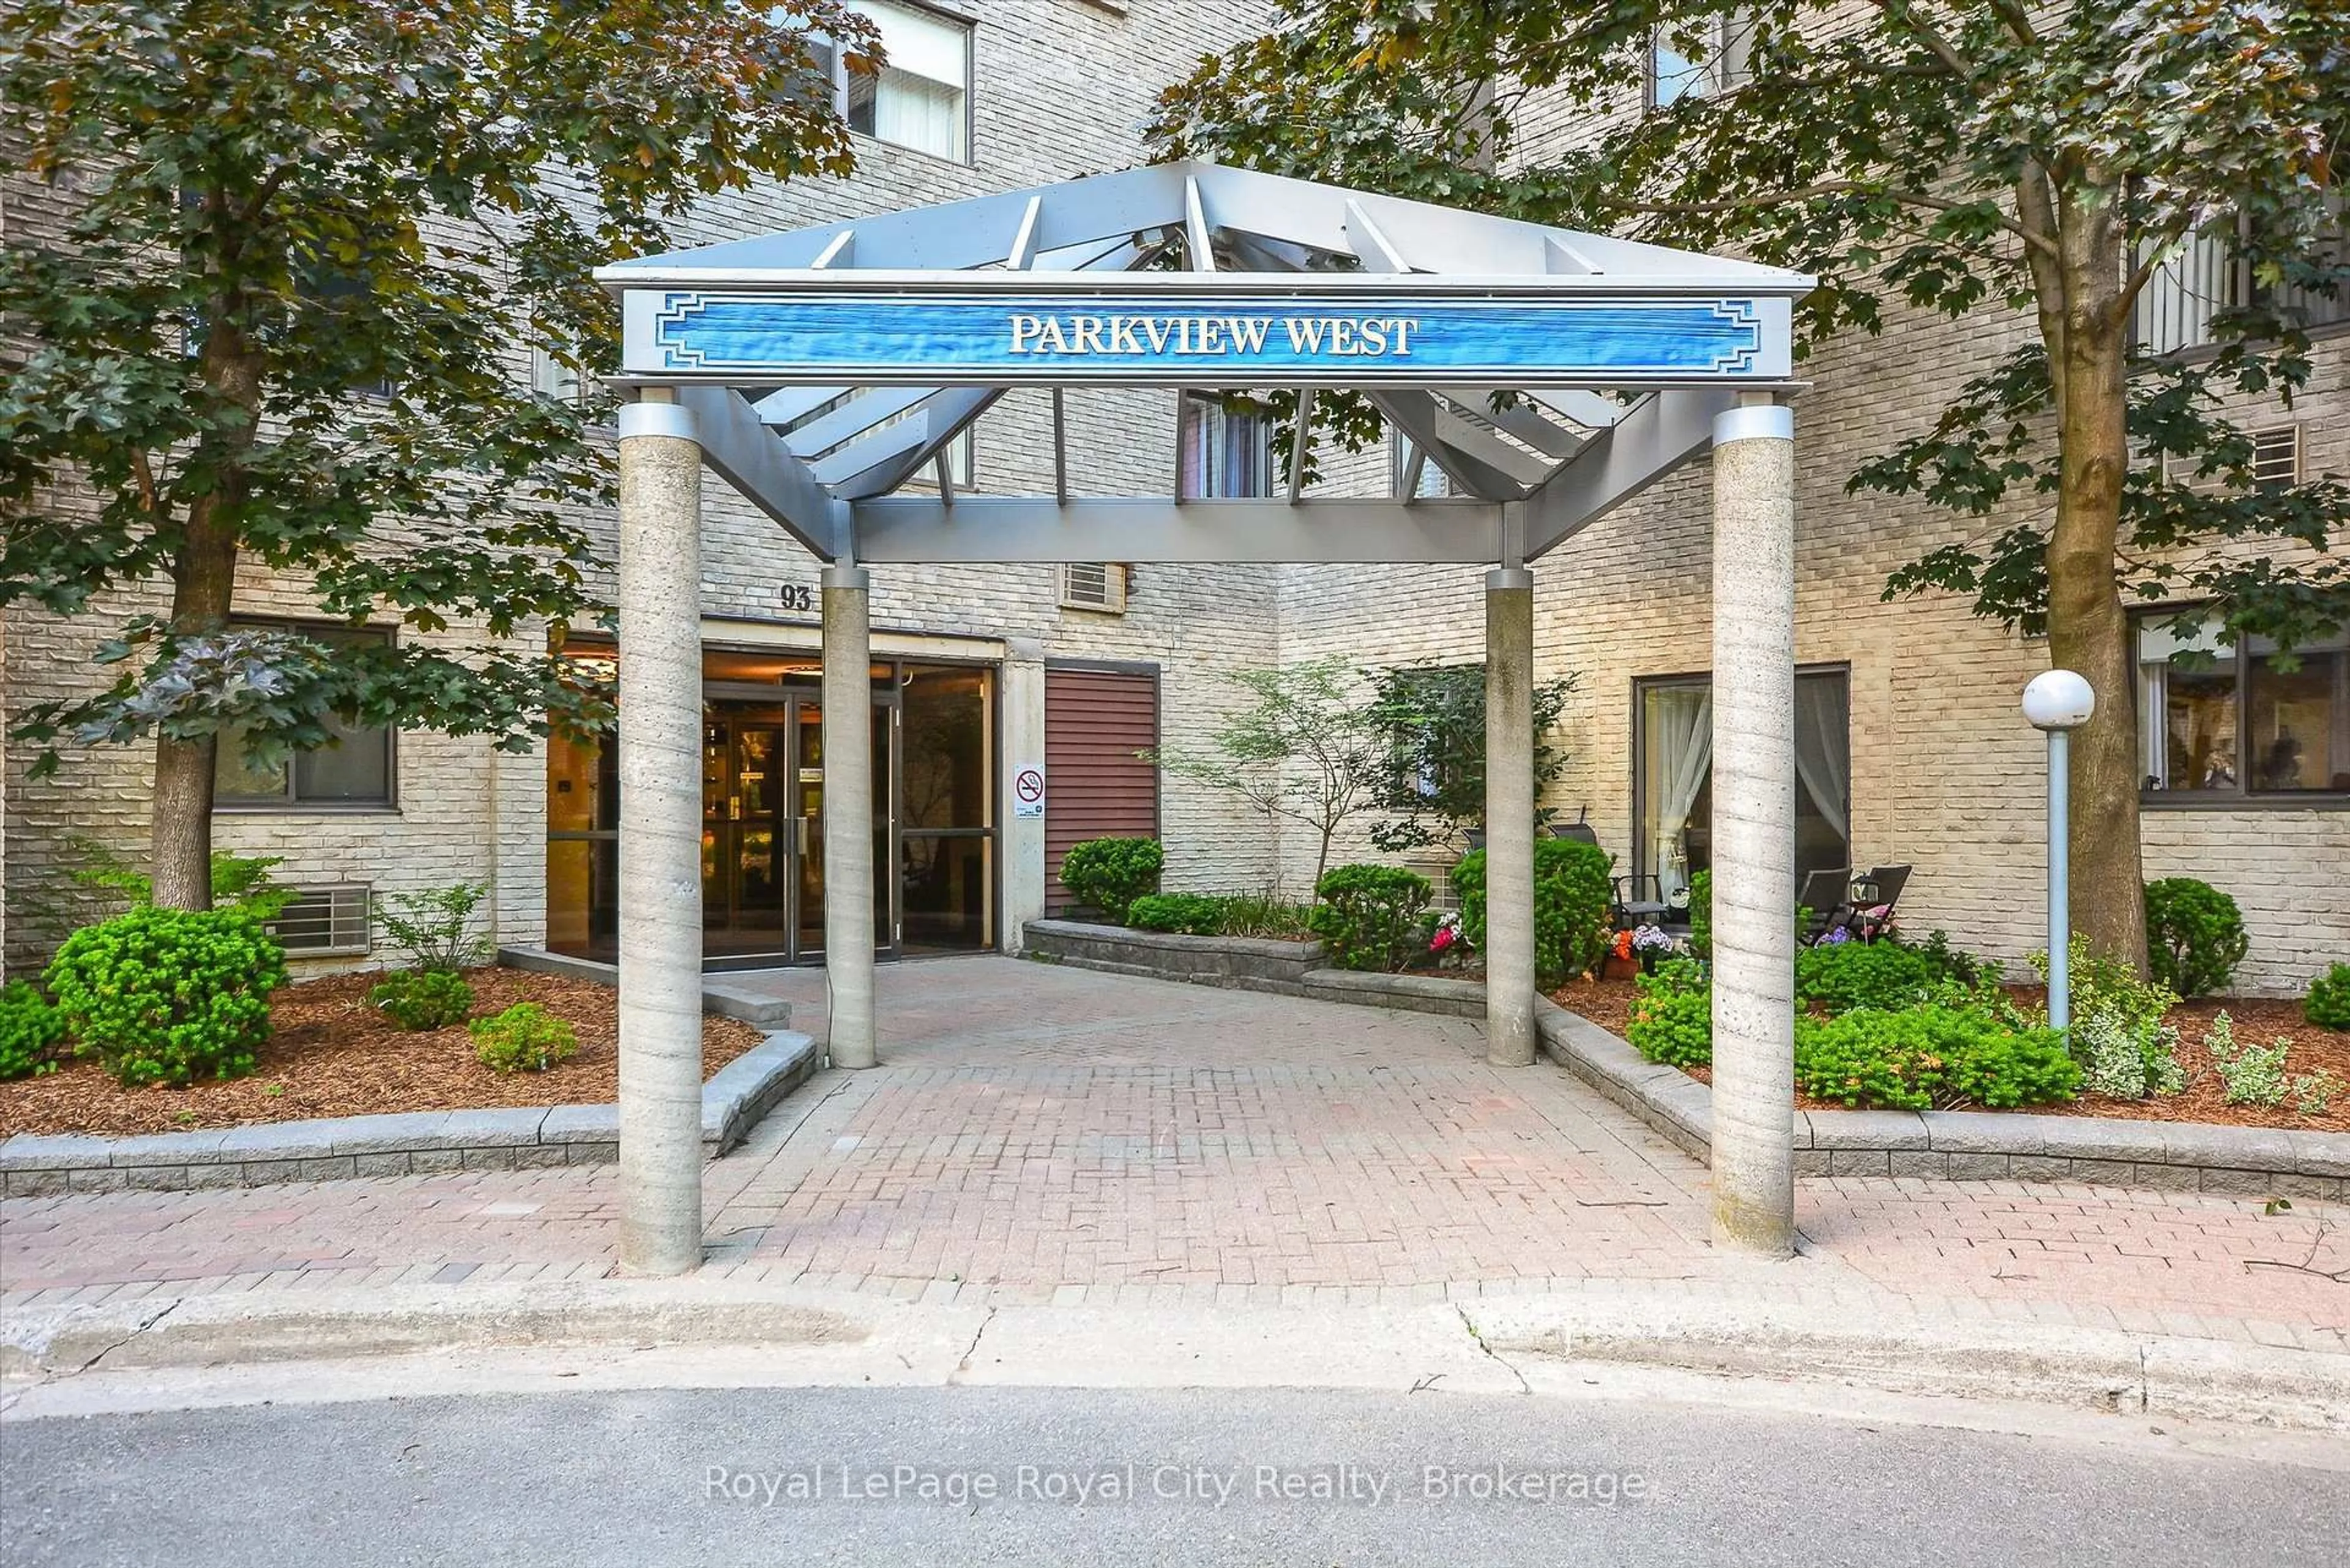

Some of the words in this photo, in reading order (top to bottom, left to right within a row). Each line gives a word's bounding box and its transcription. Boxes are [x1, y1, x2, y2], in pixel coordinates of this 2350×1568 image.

[1008, 315, 1274, 355] PARKVIEW
[1281, 317, 1420, 357] WEST
[781, 584, 810, 611] 93
